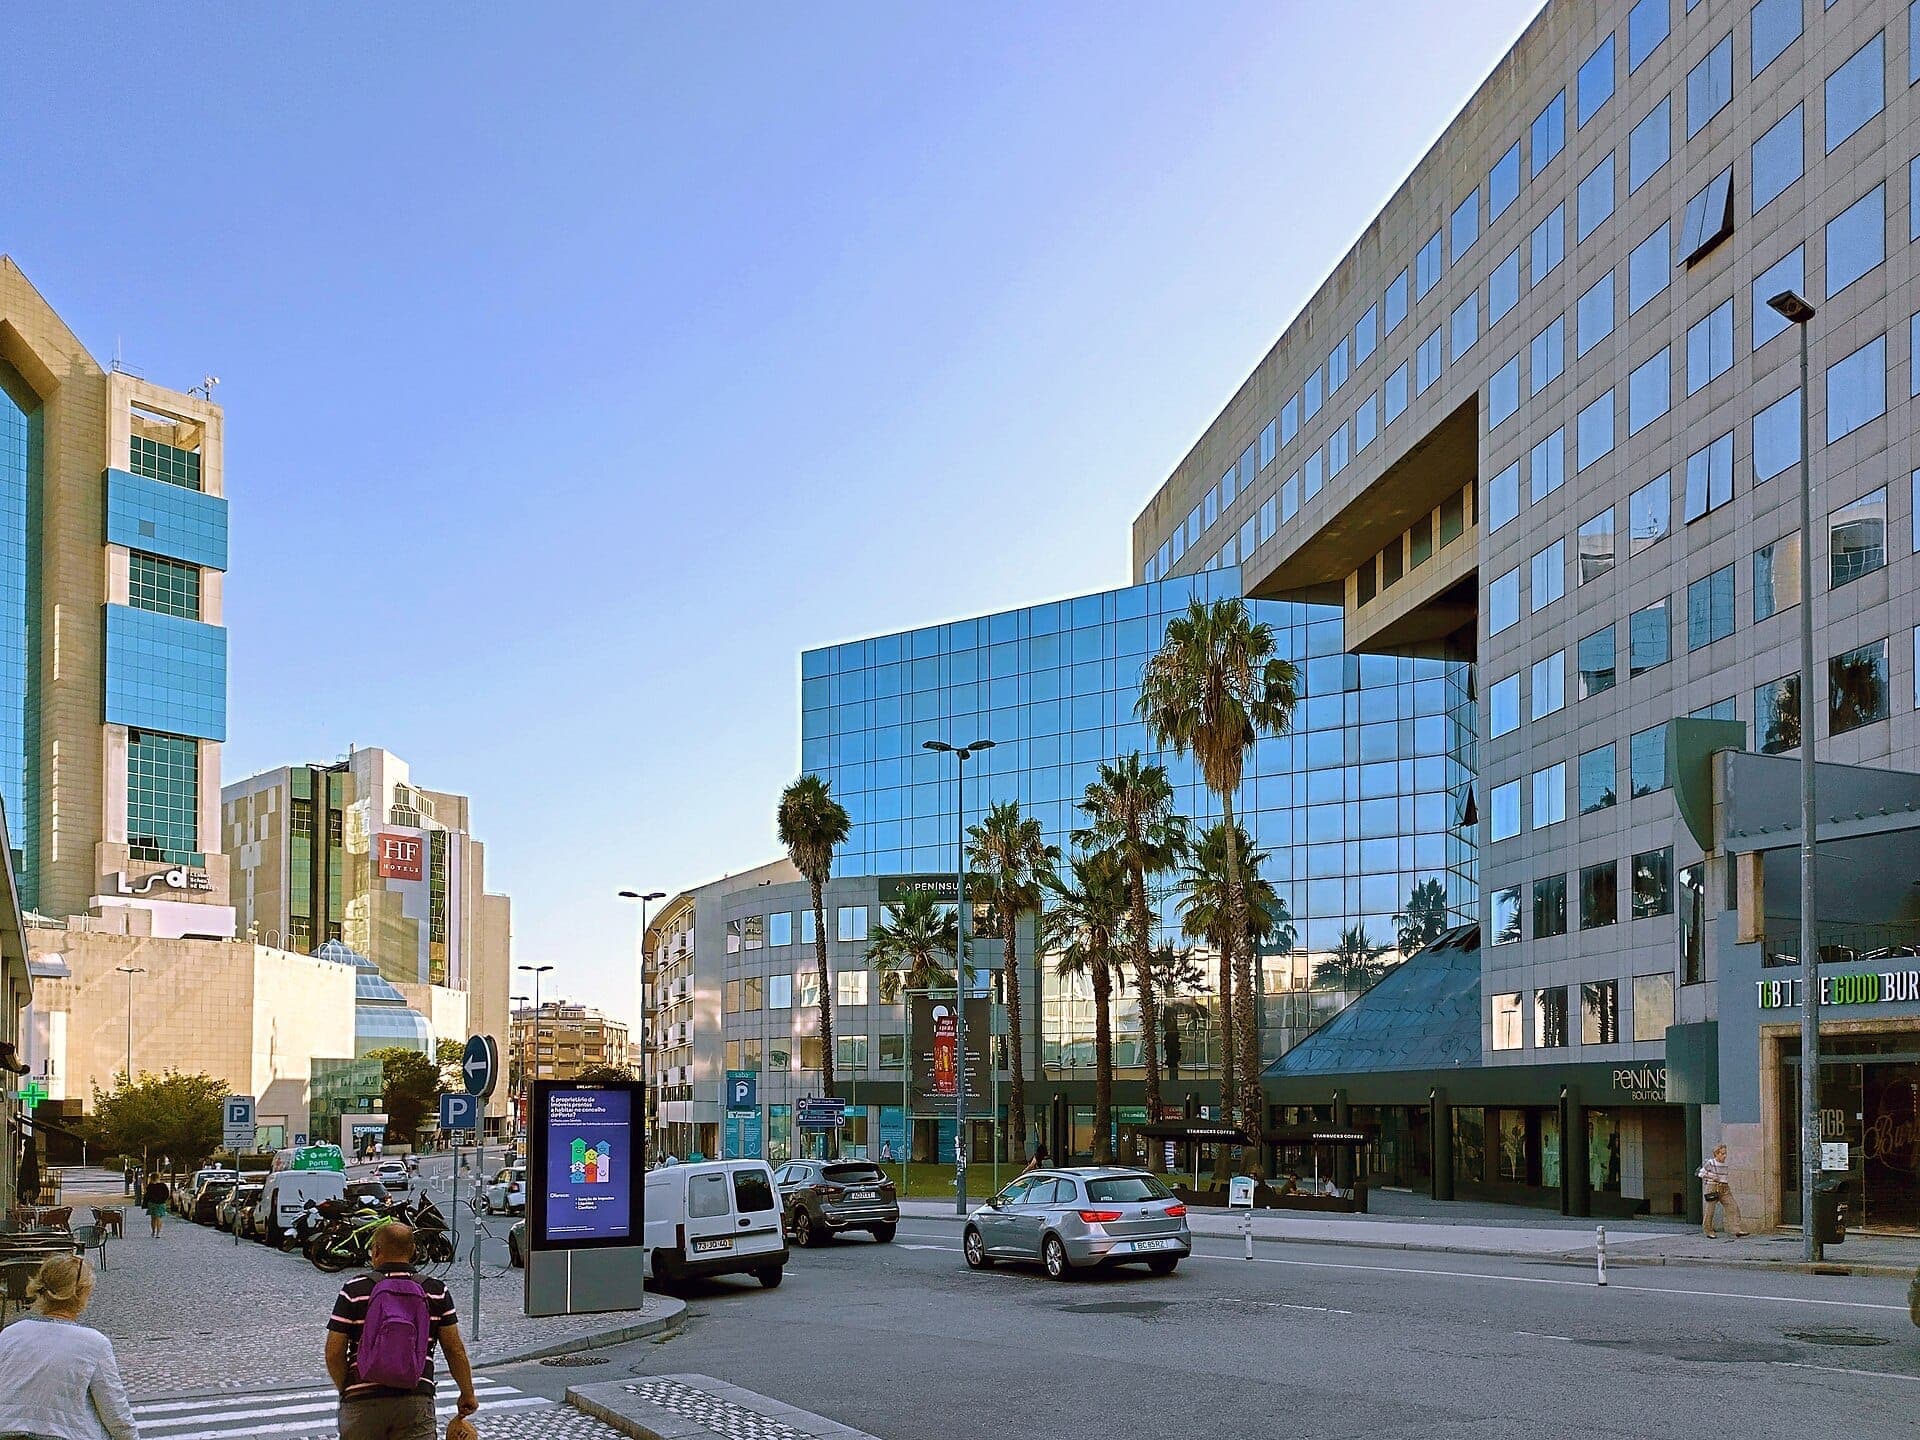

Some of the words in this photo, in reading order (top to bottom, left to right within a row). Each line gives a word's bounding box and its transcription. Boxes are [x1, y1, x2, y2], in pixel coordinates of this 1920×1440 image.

[383, 839, 419, 861] HF
[383, 863, 419, 873] HOTELS
[914, 881, 972, 891] PENÍNSUA
[1756, 980, 1782, 1009] TGB
[1833, 972, 1879, 1005] GOOD
[1885, 970, 1920, 1002] BUR
[1631, 1090, 1666, 1101] BOUTIQU
[233, 1106, 246, 1121] P
[448, 1098, 468, 1125] P
[1819, 1109, 1845, 1137] TGB
